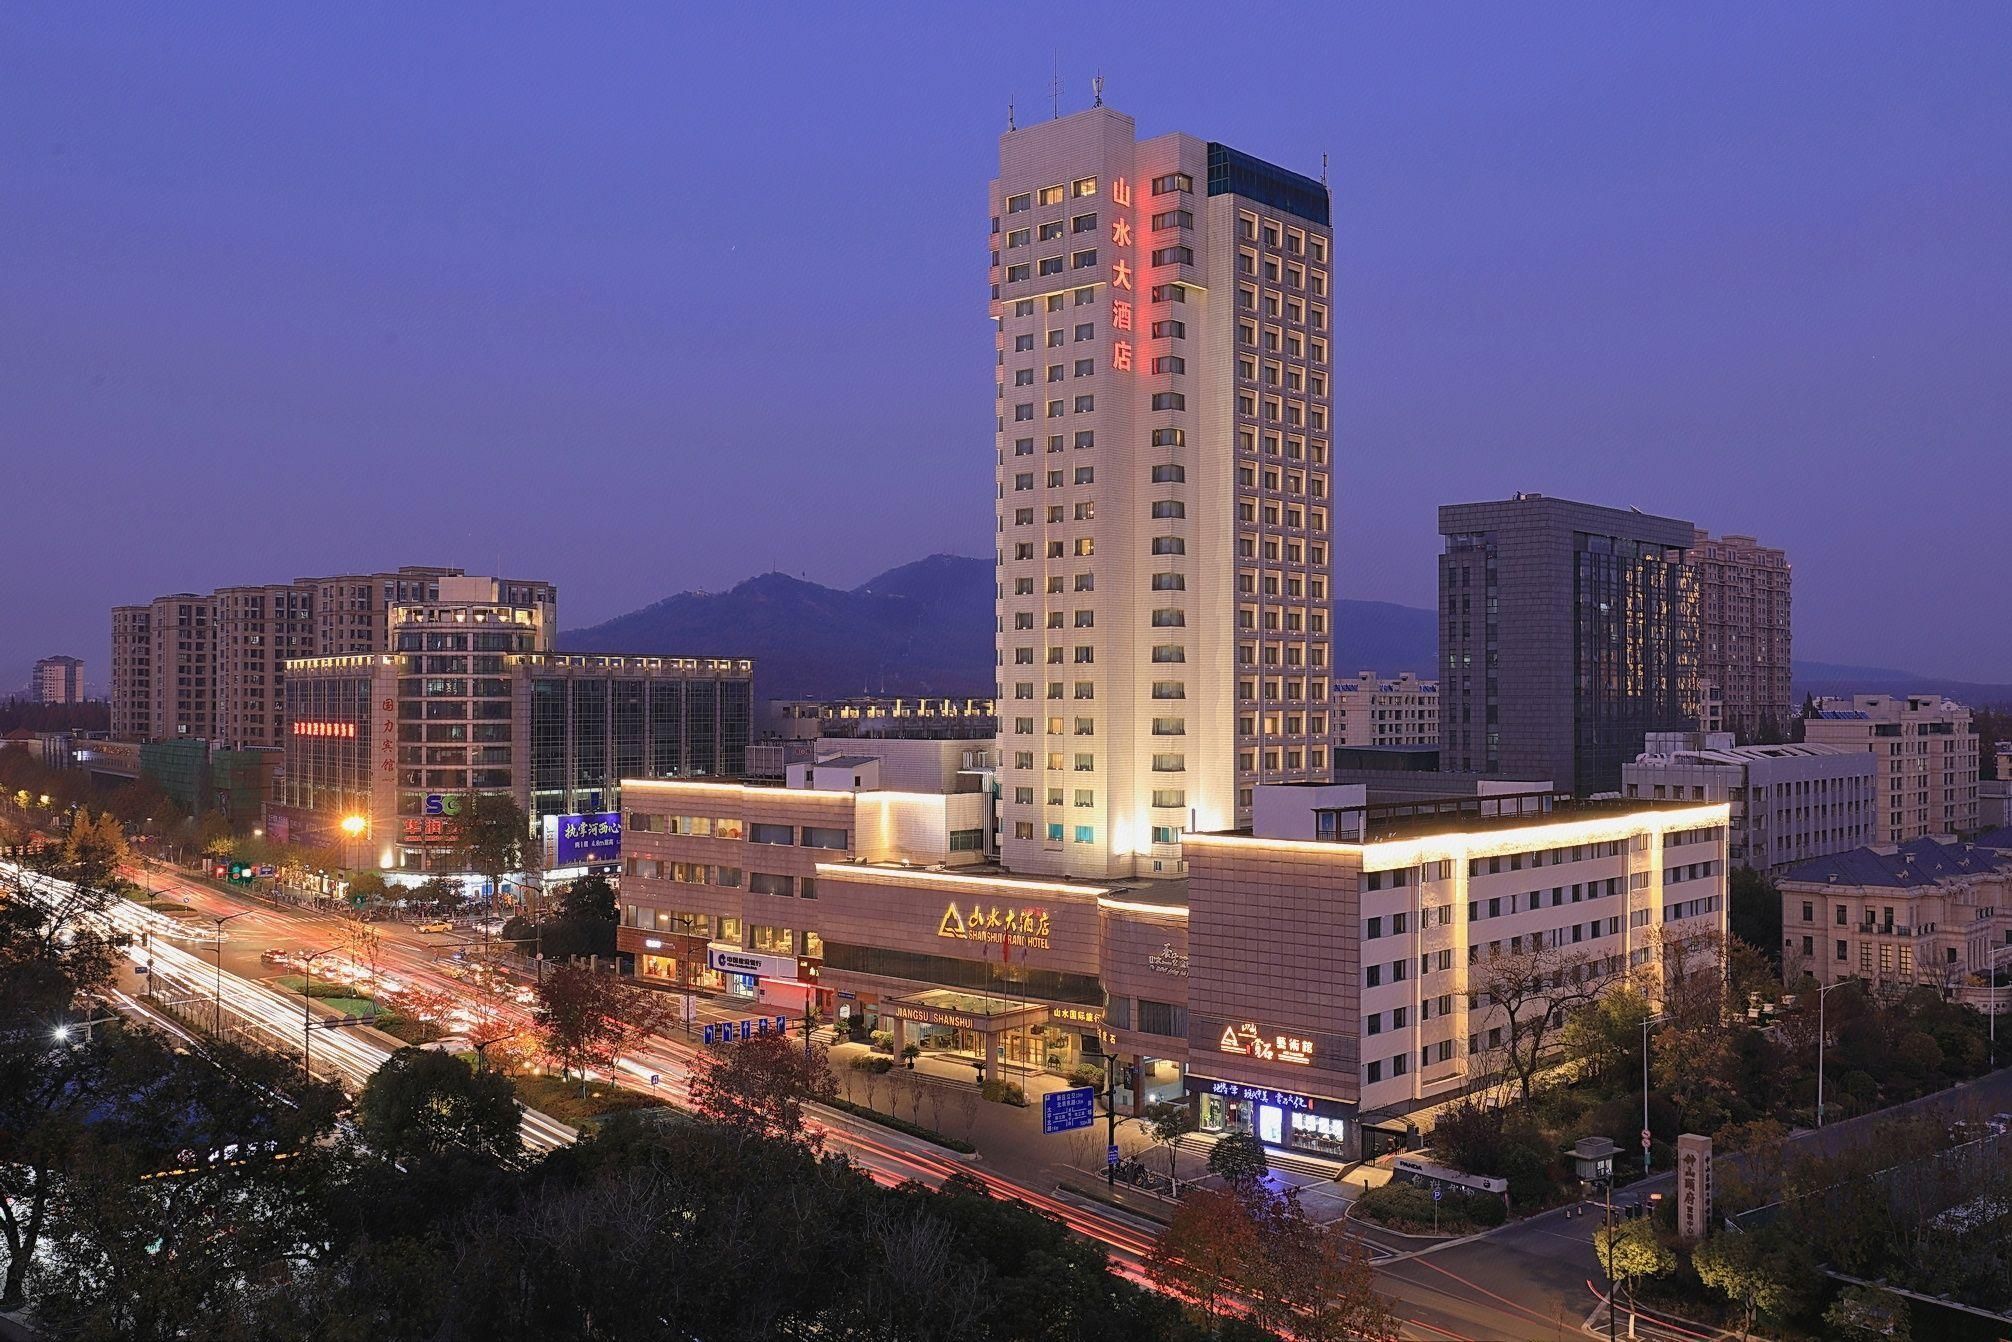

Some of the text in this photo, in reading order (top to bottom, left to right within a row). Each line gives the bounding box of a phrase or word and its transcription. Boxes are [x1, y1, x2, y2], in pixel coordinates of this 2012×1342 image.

[1112, 176, 1132, 372] 山水大酒店
[968, 905, 1050, 936] 山水大酒店
[968, 930, 1002, 943] SHANSHUI
[1027, 937, 1050, 949] HOTEL
[895, 1007, 973, 1028] JIANGSU SHANSHUI
[1399, 1160, 1423, 1171] PANDA
